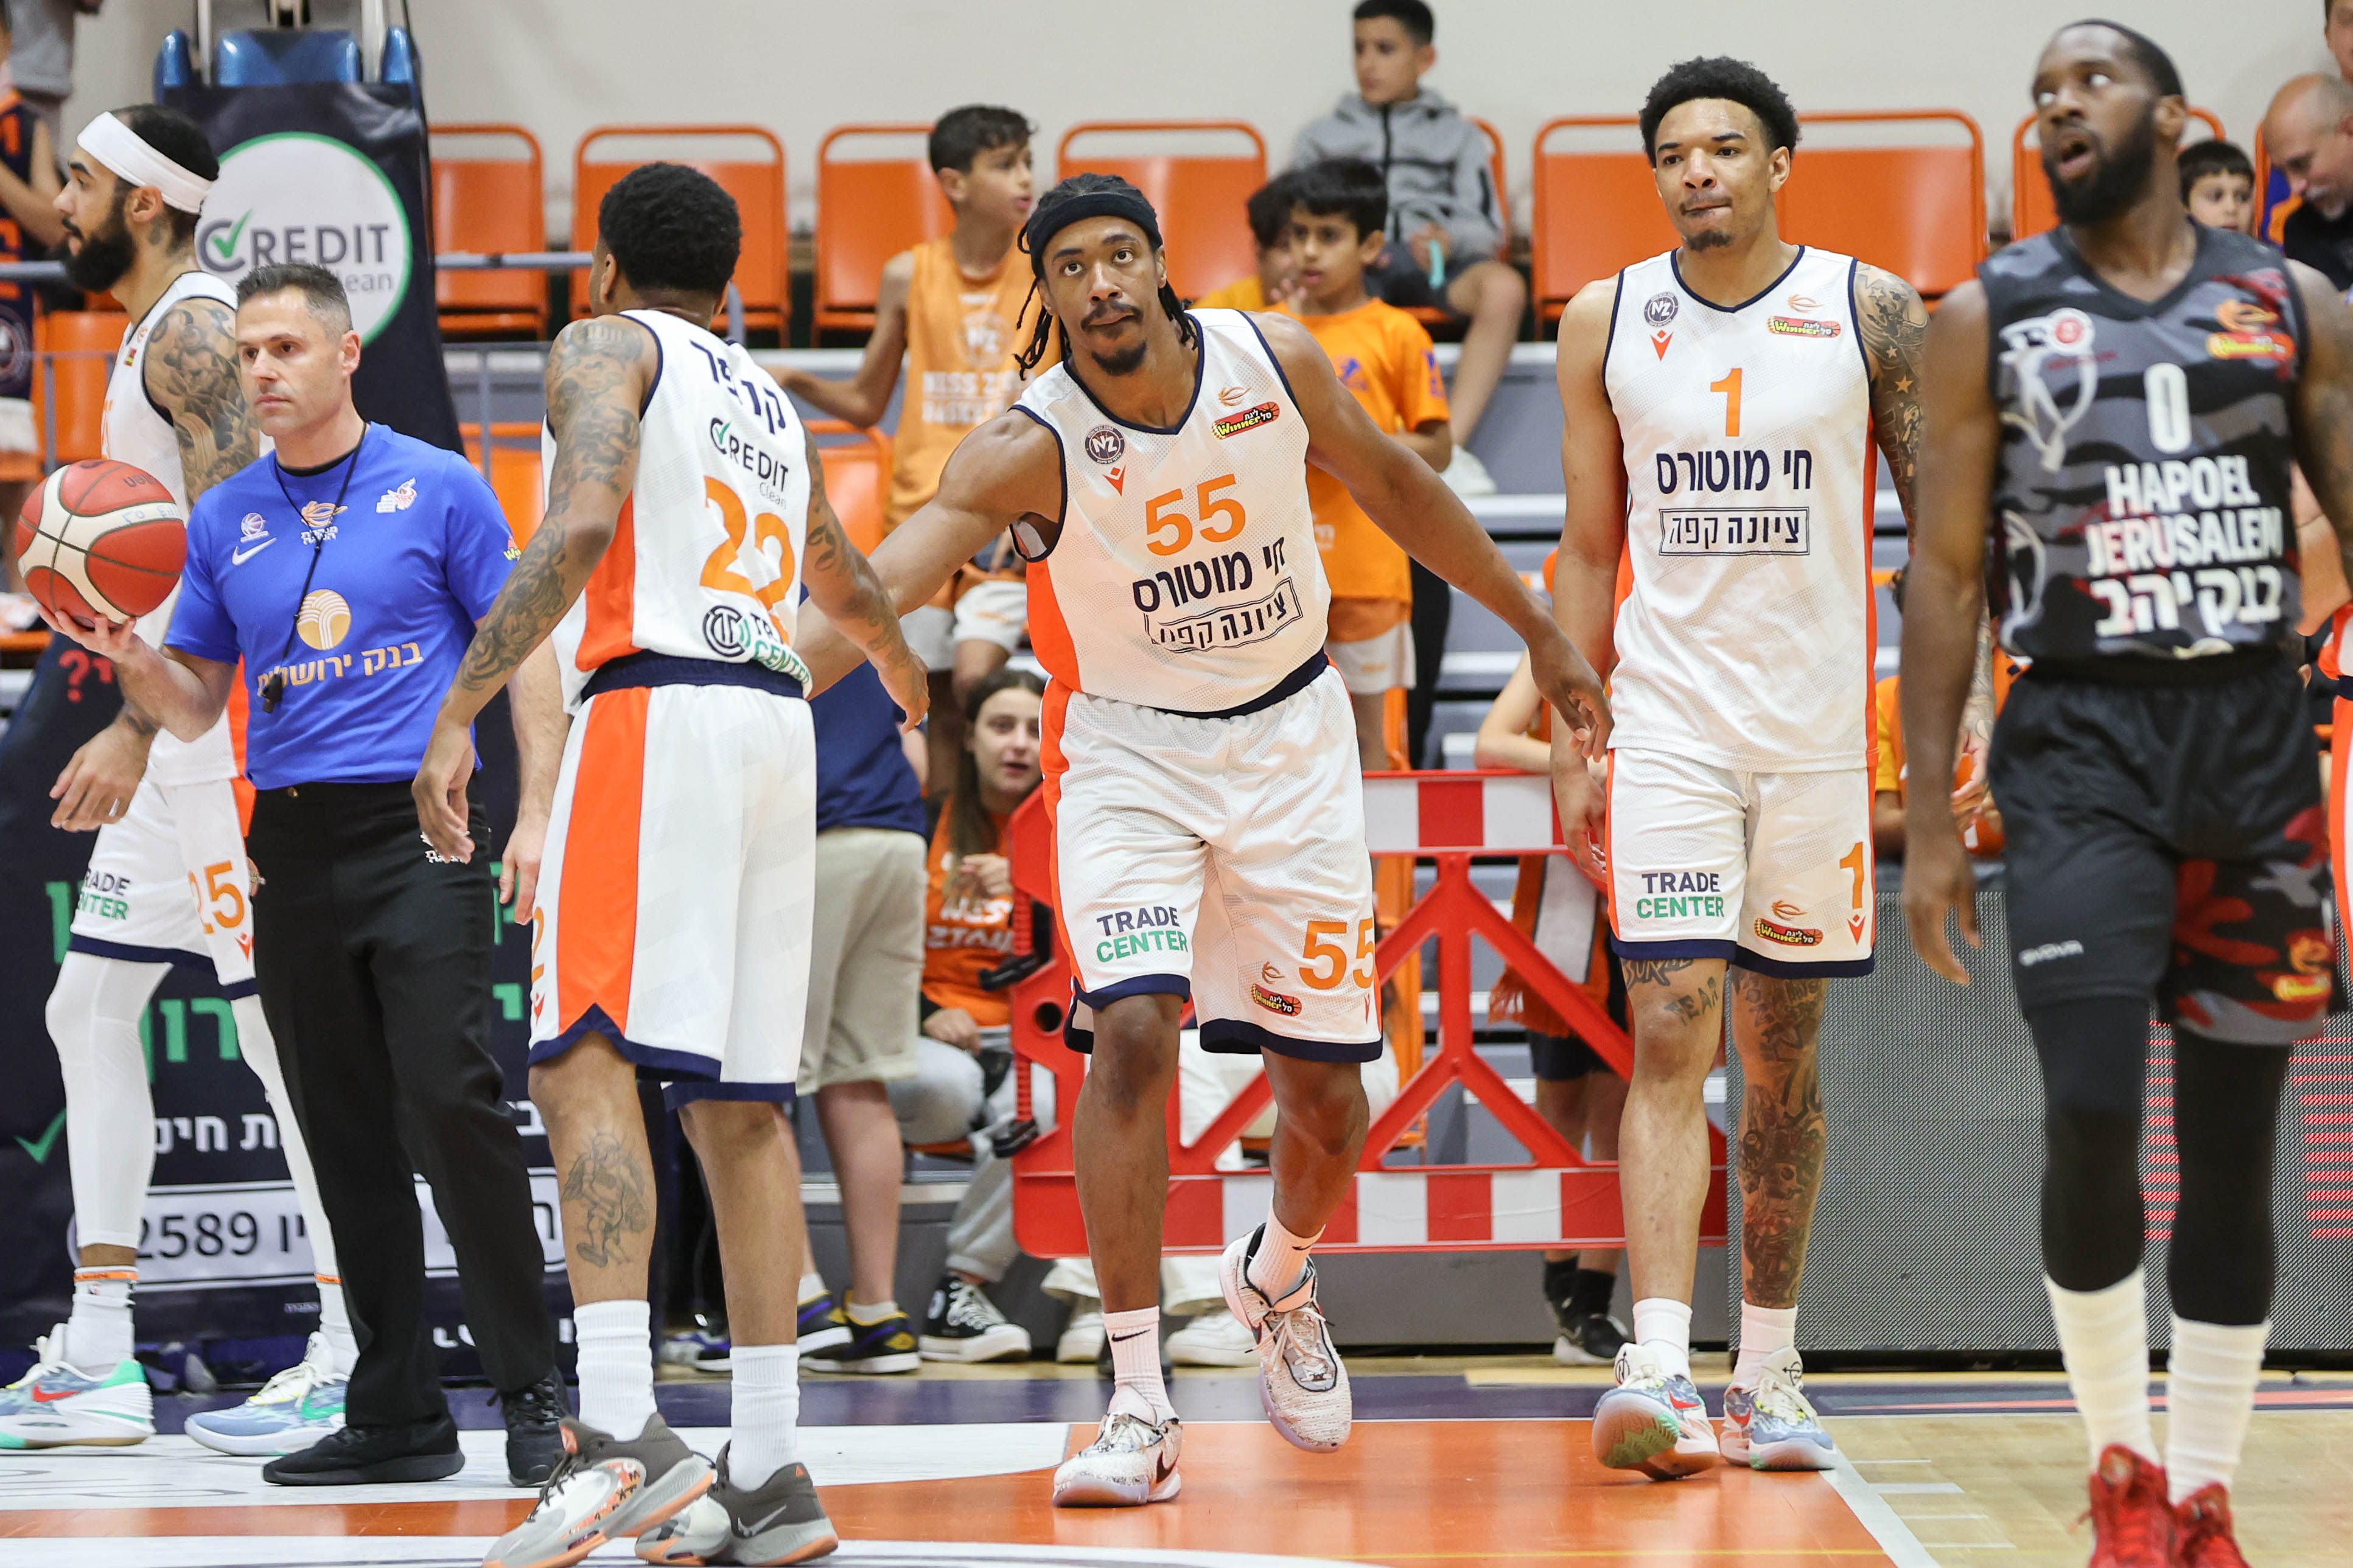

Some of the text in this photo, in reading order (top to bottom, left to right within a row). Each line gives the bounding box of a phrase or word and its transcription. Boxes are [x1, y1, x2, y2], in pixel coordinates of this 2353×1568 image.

[197, 218, 390, 272] CREDIT
[1774, 320, 1819, 335] Winner
[1217, 416, 1261, 436] Winner
[1710, 368, 1743, 437] 1
[2144, 361, 2192, 454] 0
[710, 417, 789, 492] CREDIT
[1656, 449, 1812, 494] חי מוטורס
[2104, 455, 2261, 517] HAPOEL
[1145, 473, 1246, 556] 55
[1669, 517, 1799, 549] ציונה קפה
[699, 475, 796, 648] 22
[1262, 536, 1285, 576] חי
[1132, 551, 1253, 613] מוטורס
[2089, 565, 2282, 638] בנק יהב
[1220, 591, 1287, 641] ציונה
[361, 642, 424, 677] בנק
[85, 866, 130, 896] RADE
[1642, 871, 1721, 894] TRADE
[1839, 841, 1865, 910] 1
[1096, 906, 1180, 936] TRADE
[1637, 896, 1725, 919] CENTER
[1096, 930, 1189, 963] CENTER
[1298, 917, 1375, 991] 55
[1760, 923, 1802, 944] Winner
